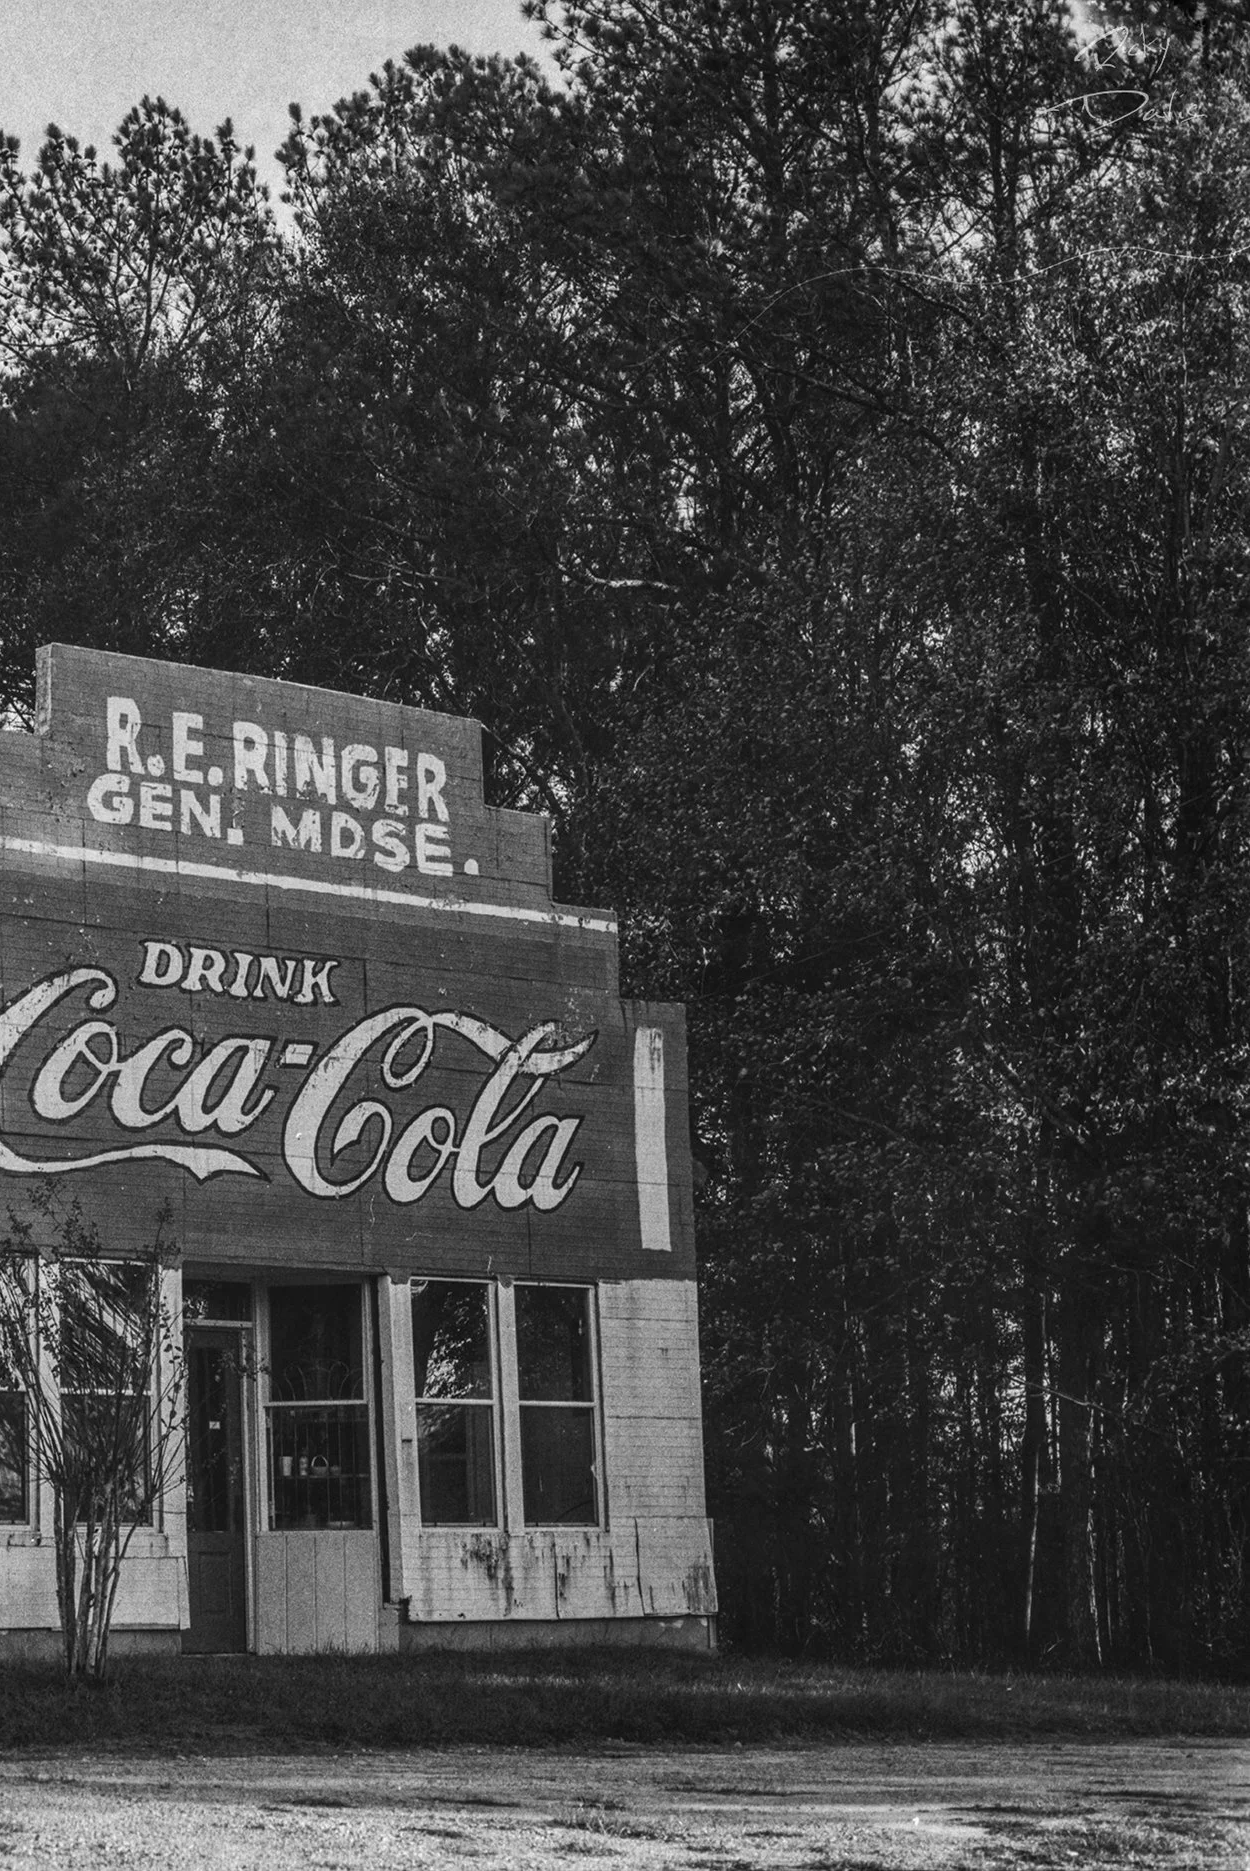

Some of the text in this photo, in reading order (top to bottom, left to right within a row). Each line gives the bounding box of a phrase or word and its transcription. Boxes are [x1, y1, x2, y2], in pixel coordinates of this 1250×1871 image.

[87, 773, 479, 877] GEN. MDSE.
[141, 940, 338, 1003] DRINK
